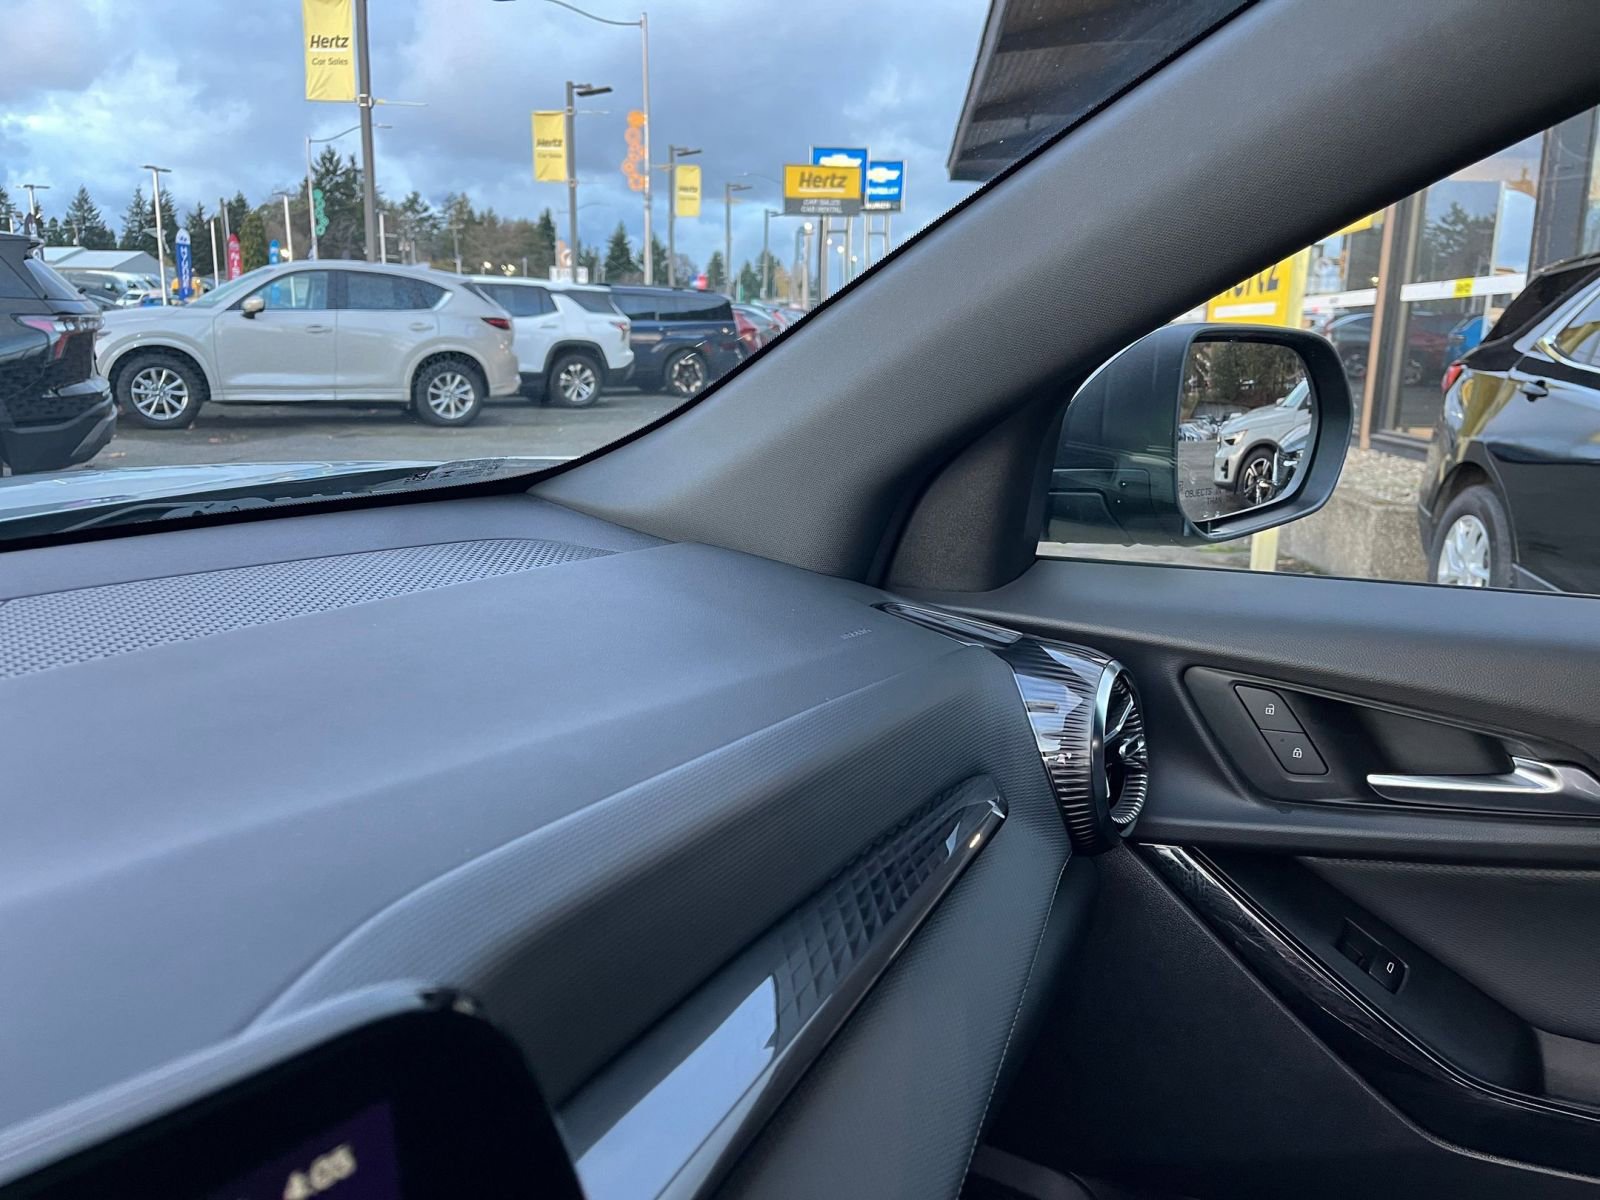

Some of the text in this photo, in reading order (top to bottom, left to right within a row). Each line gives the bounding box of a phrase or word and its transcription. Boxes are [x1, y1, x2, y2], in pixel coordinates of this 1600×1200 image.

[310, 34, 349, 48] Hertz
[311, 57, 348, 66] Car Sales
[799, 172, 848, 188] Hertz
[1184, 487, 1213, 498] OBJECTS
